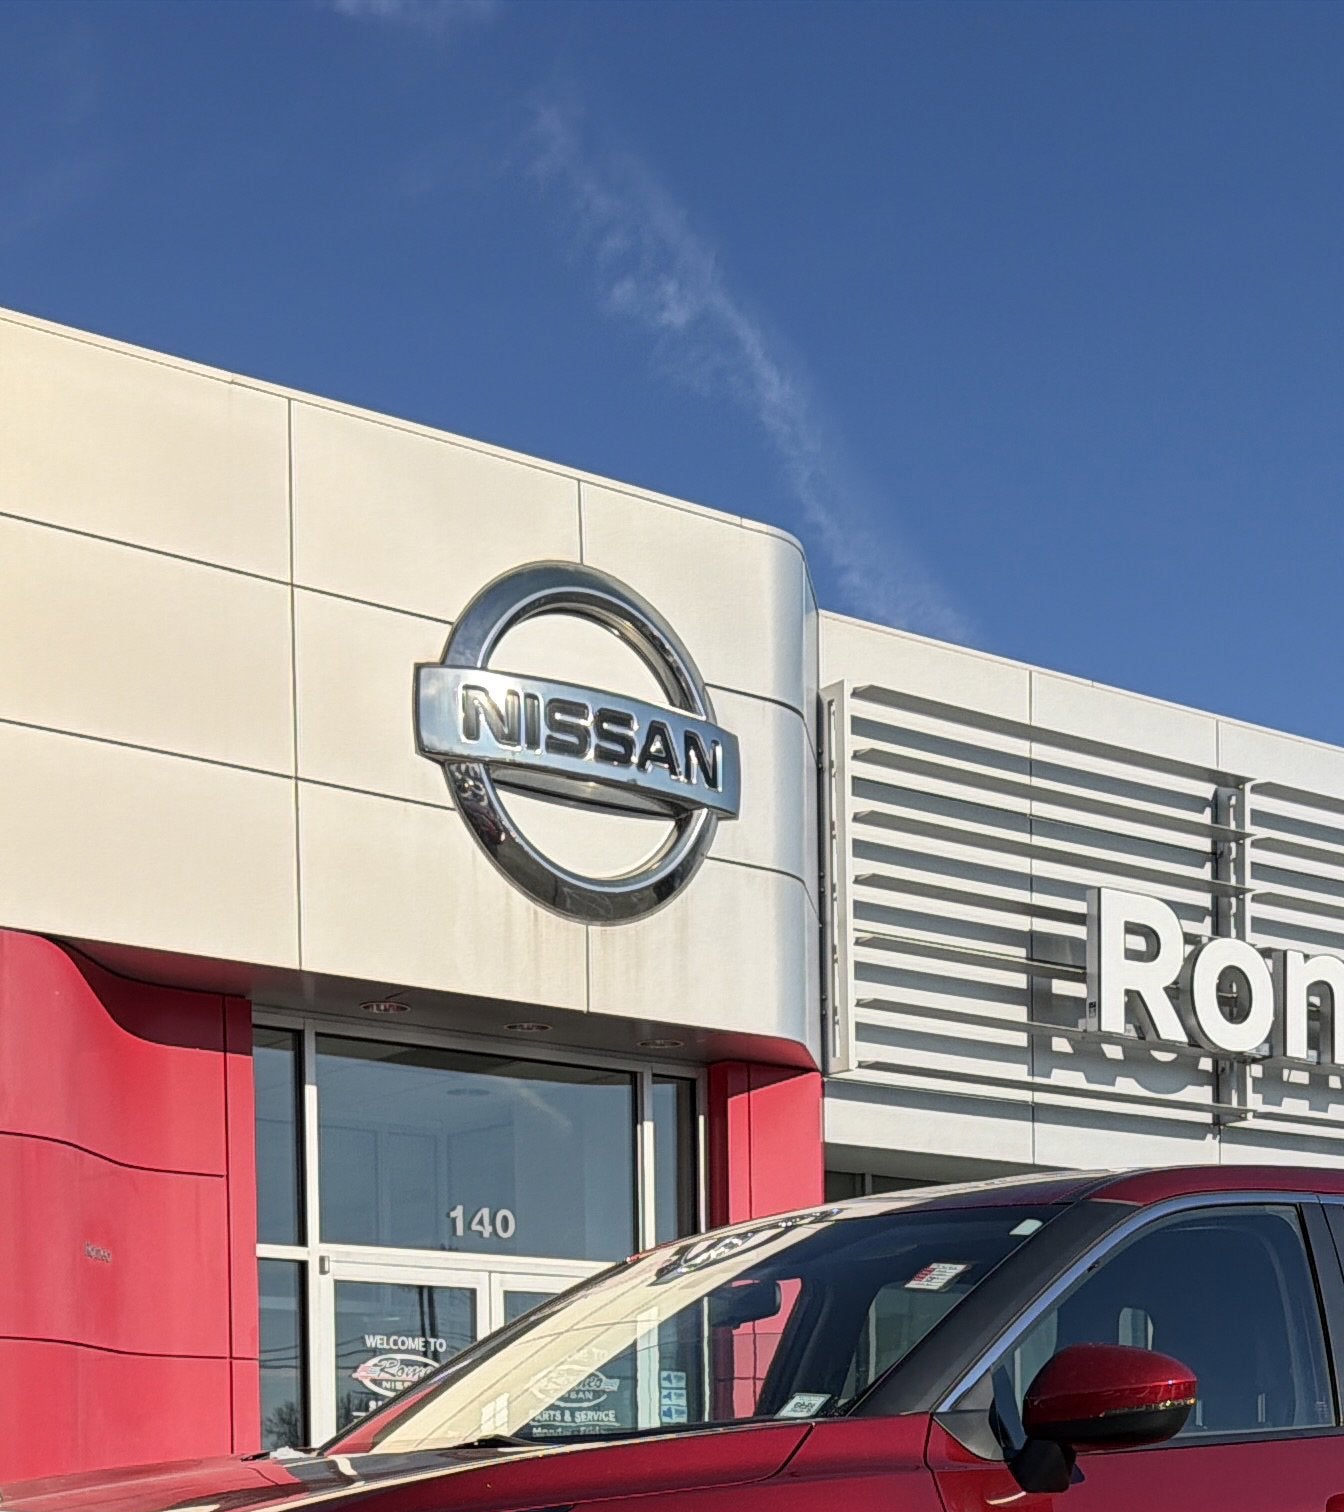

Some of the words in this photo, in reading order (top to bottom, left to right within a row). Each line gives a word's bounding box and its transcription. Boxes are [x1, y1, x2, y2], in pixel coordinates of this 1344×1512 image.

[458, 683, 723, 793] NISSAN
[449, 1204, 516, 1239] 140
[364, 1334, 427, 1351] WELCOME
[427, 1338, 447, 1352] TO
[564, 1409, 572, 1422] &
[574, 1410, 616, 1422] SERVICE
